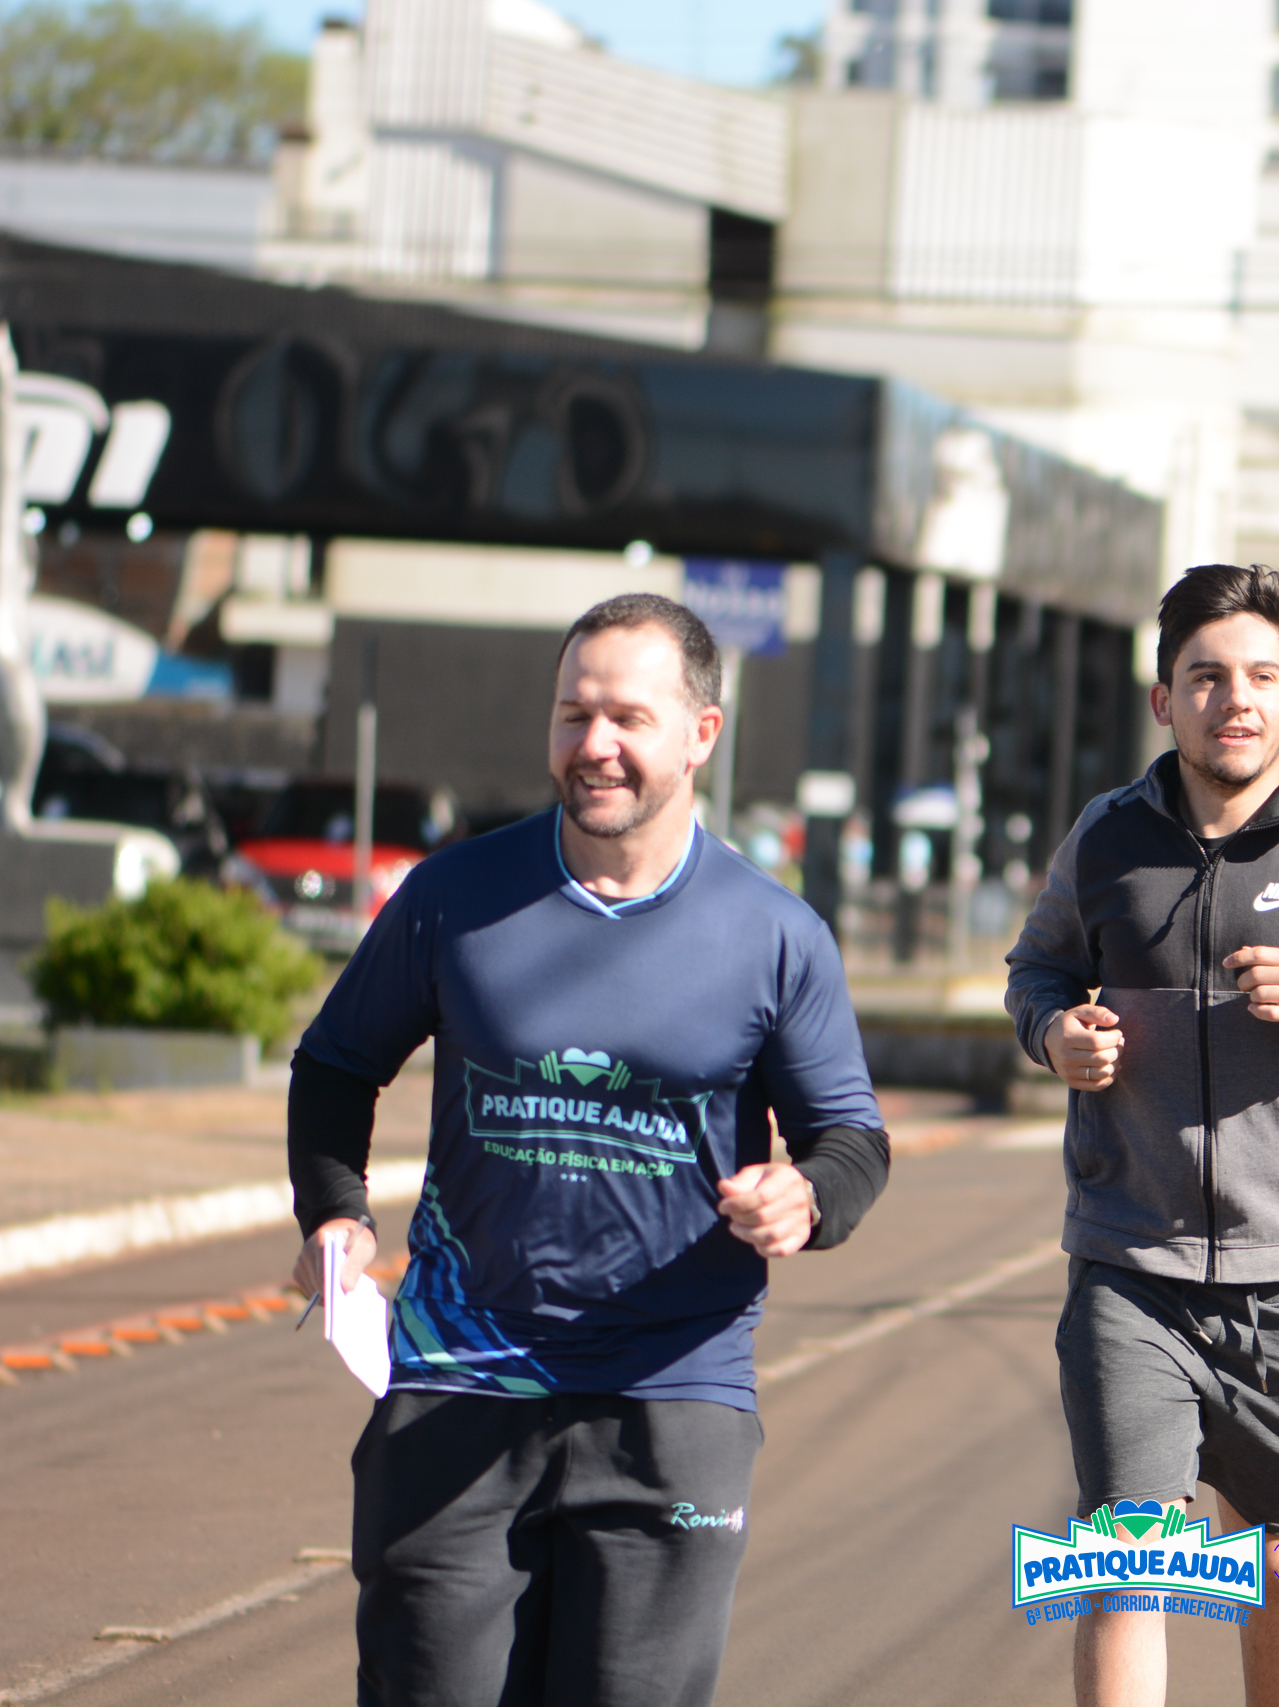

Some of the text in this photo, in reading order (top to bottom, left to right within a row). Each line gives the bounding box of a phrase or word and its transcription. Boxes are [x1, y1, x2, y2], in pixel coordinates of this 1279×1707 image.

[481, 1093, 687, 1144] PRATIQUE AJUDA
[484, 1140, 675, 1180] EDUCAÇÃO FÍSICA EM AÇÃO
